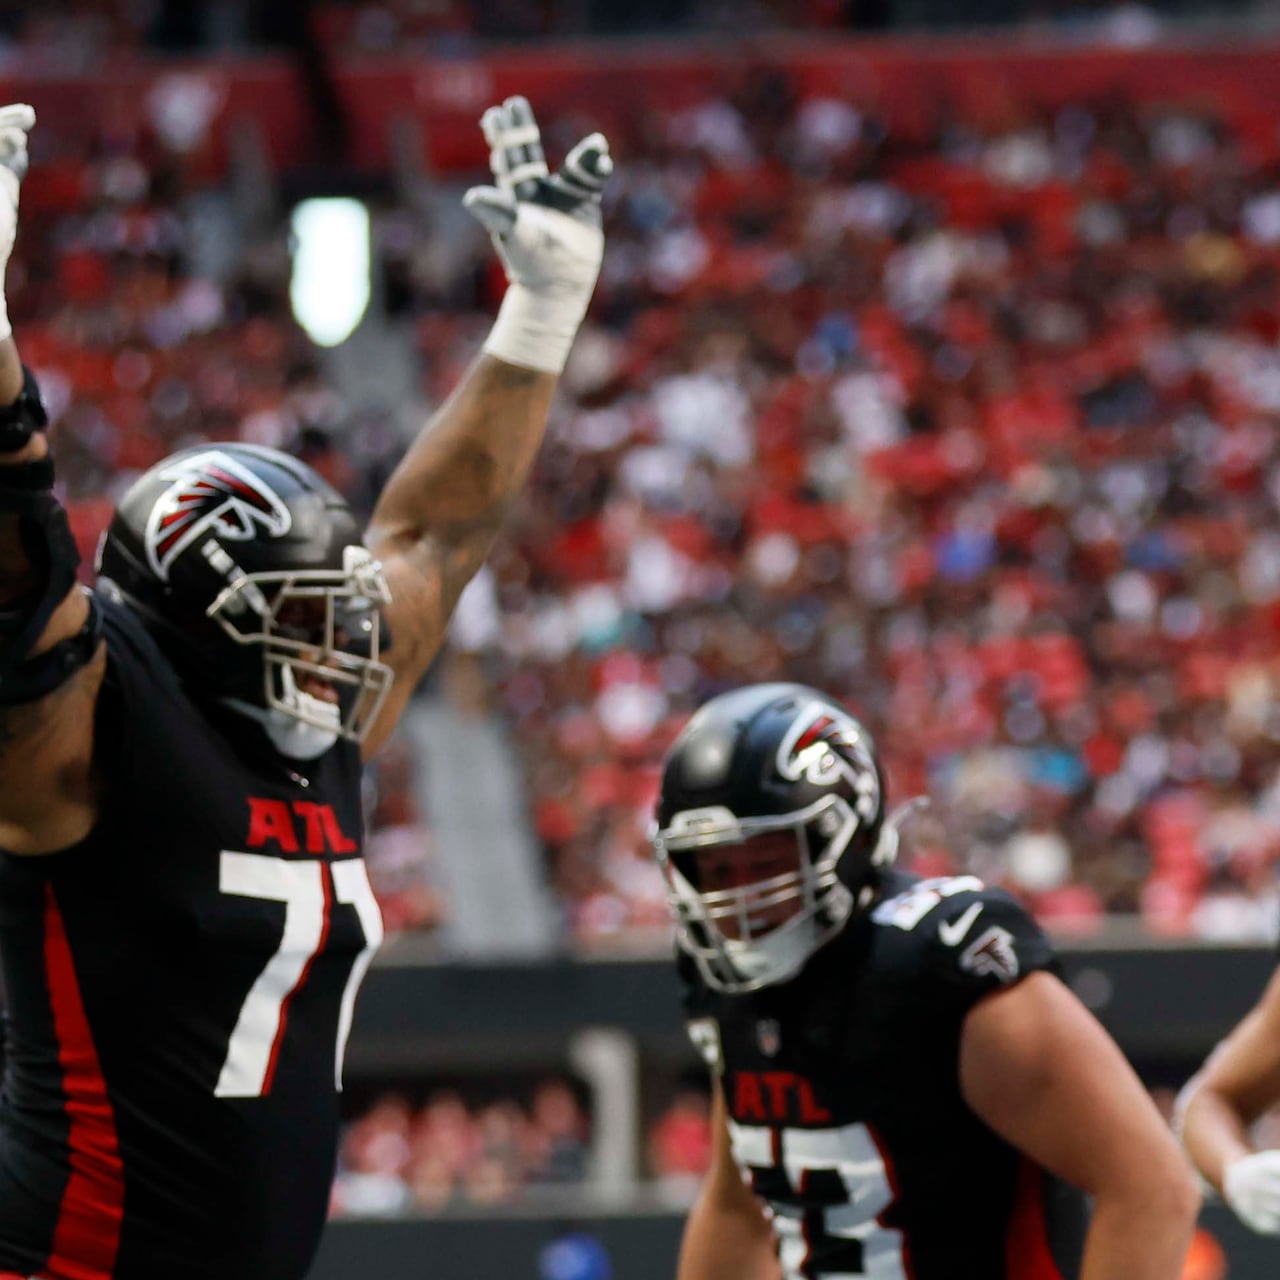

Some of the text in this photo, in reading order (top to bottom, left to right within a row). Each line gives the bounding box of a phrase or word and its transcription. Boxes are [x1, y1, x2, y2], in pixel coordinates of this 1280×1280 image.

[246, 797, 358, 855] ATL
[214, 850, 386, 1099] 77
[733, 1072, 830, 1122] ATL
